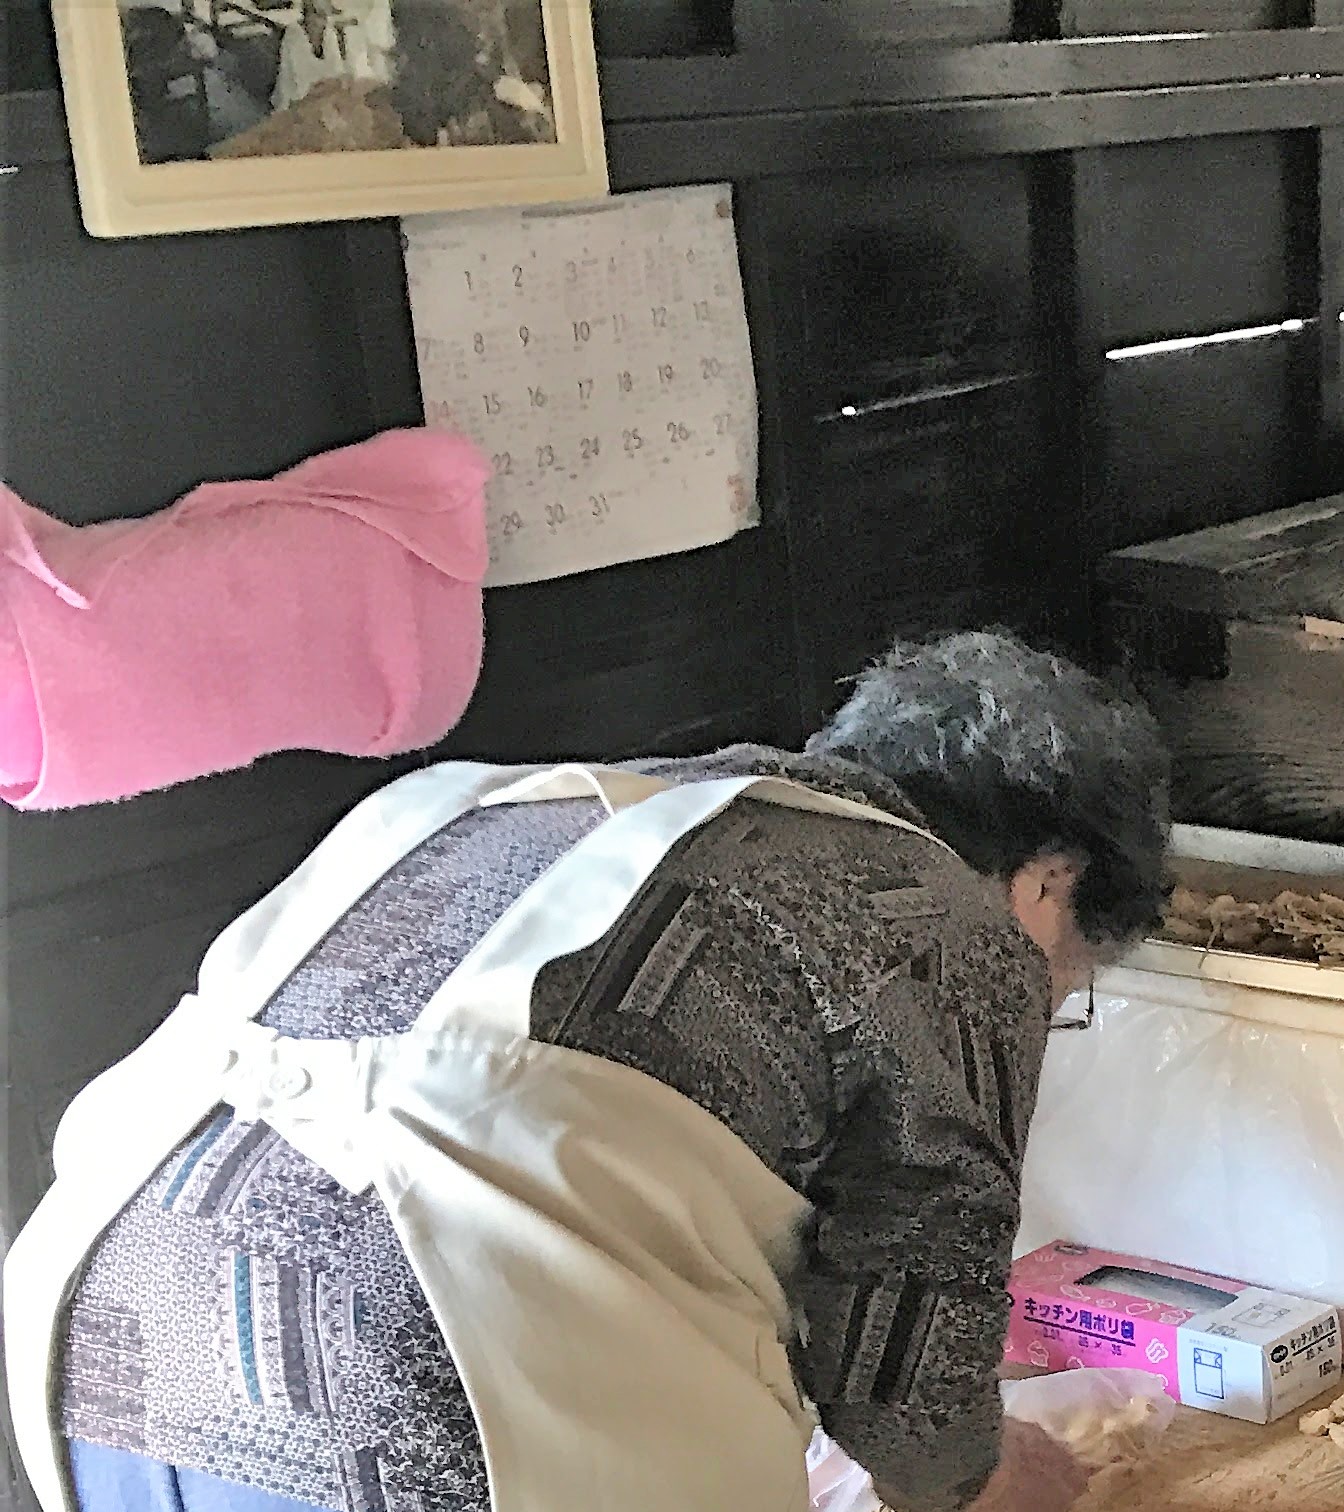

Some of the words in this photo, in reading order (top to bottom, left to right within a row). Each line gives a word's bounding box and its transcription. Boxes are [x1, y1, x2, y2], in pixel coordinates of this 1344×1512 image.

[463, 271, 473, 290] 1
[512, 264, 523, 287] 2
[473, 332, 485, 354] 8
[519, 324, 530, 347] 9
[571, 320, 591, 342] 10
[651, 306, 668, 328] 12
[482, 393, 502, 416] 15
[527, 385, 549, 408] 16
[577, 378, 594, 401] 17
[657, 363, 674, 384] 19
[535, 444, 555, 468] 23
[580, 436, 600, 459] 24
[622, 427, 643, 452] 25
[667, 421, 690, 443] 26
[544, 502, 566, 527] 30
[588, 492, 610, 518] 31
[1023, 1297, 1135, 1341] キッチン用ポリ袋
